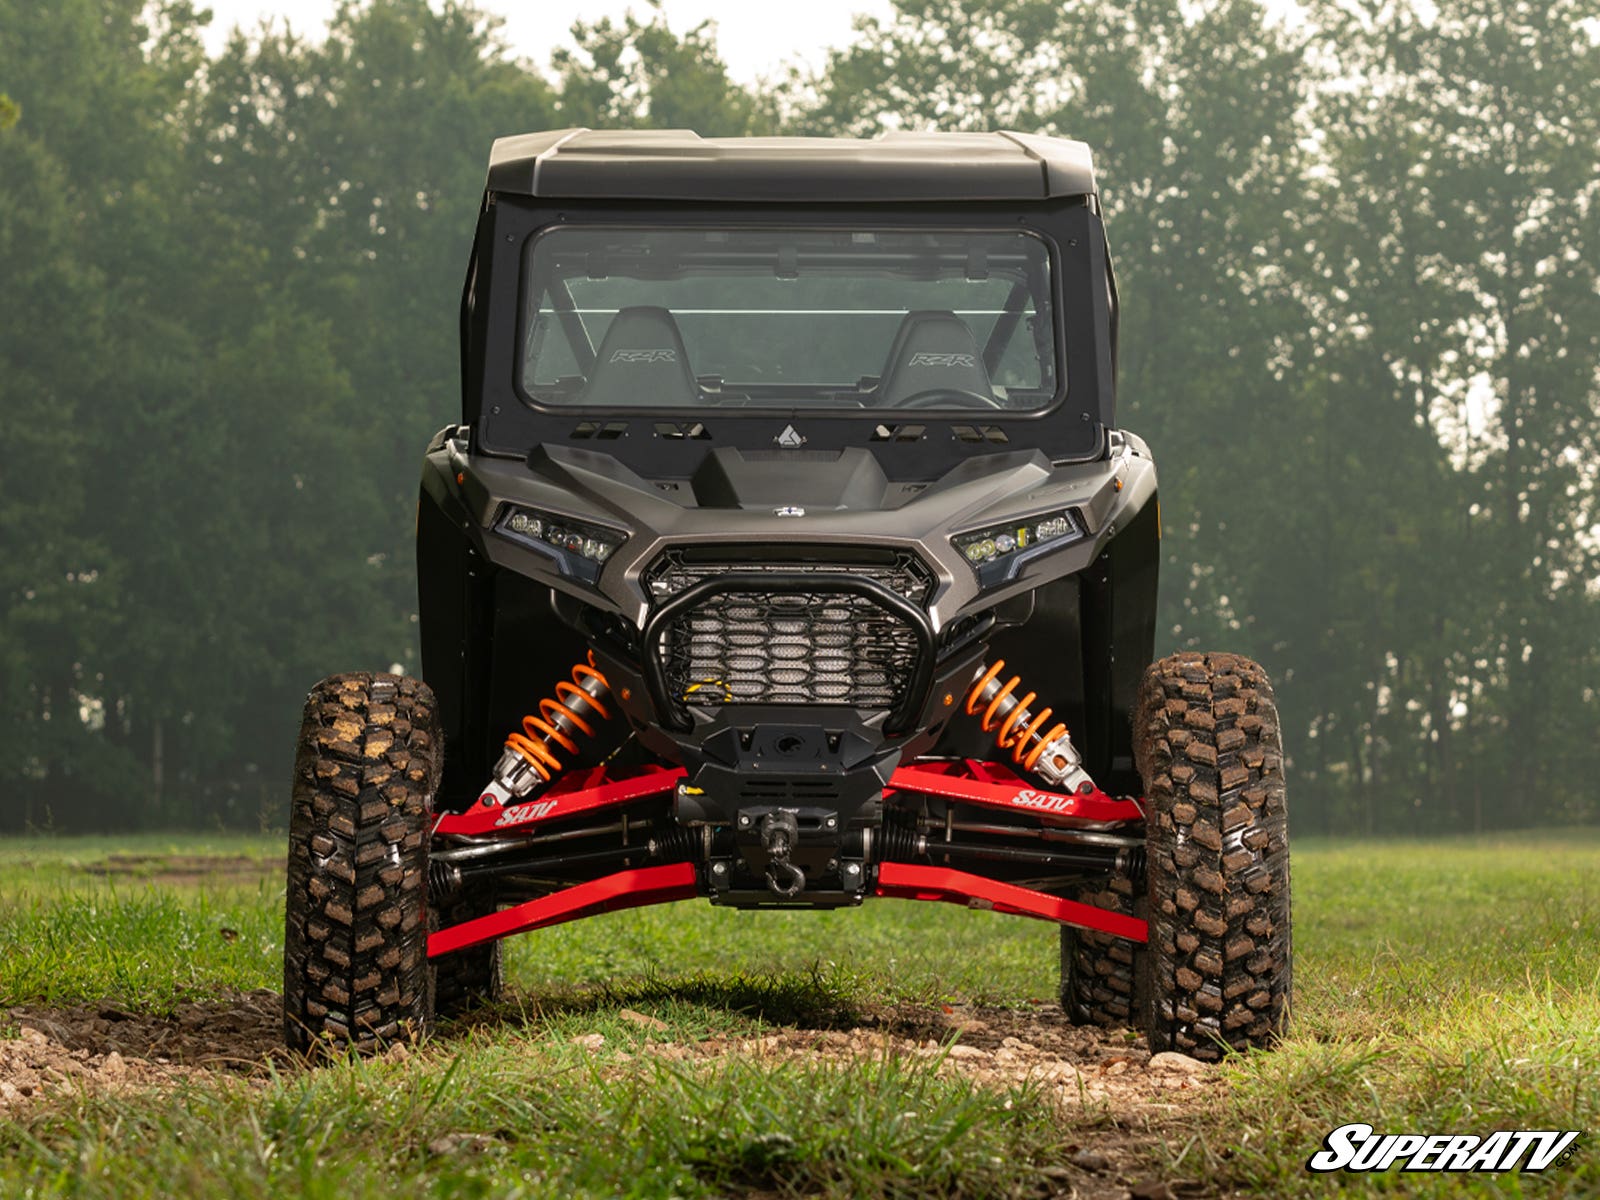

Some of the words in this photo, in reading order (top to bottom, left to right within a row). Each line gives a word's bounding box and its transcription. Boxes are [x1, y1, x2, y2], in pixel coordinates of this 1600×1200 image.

[609, 348, 676, 363] RZR
[908, 352, 975, 367] RZR
[1012, 789, 1075, 812] SATV
[494, 799, 558, 826] SATV
